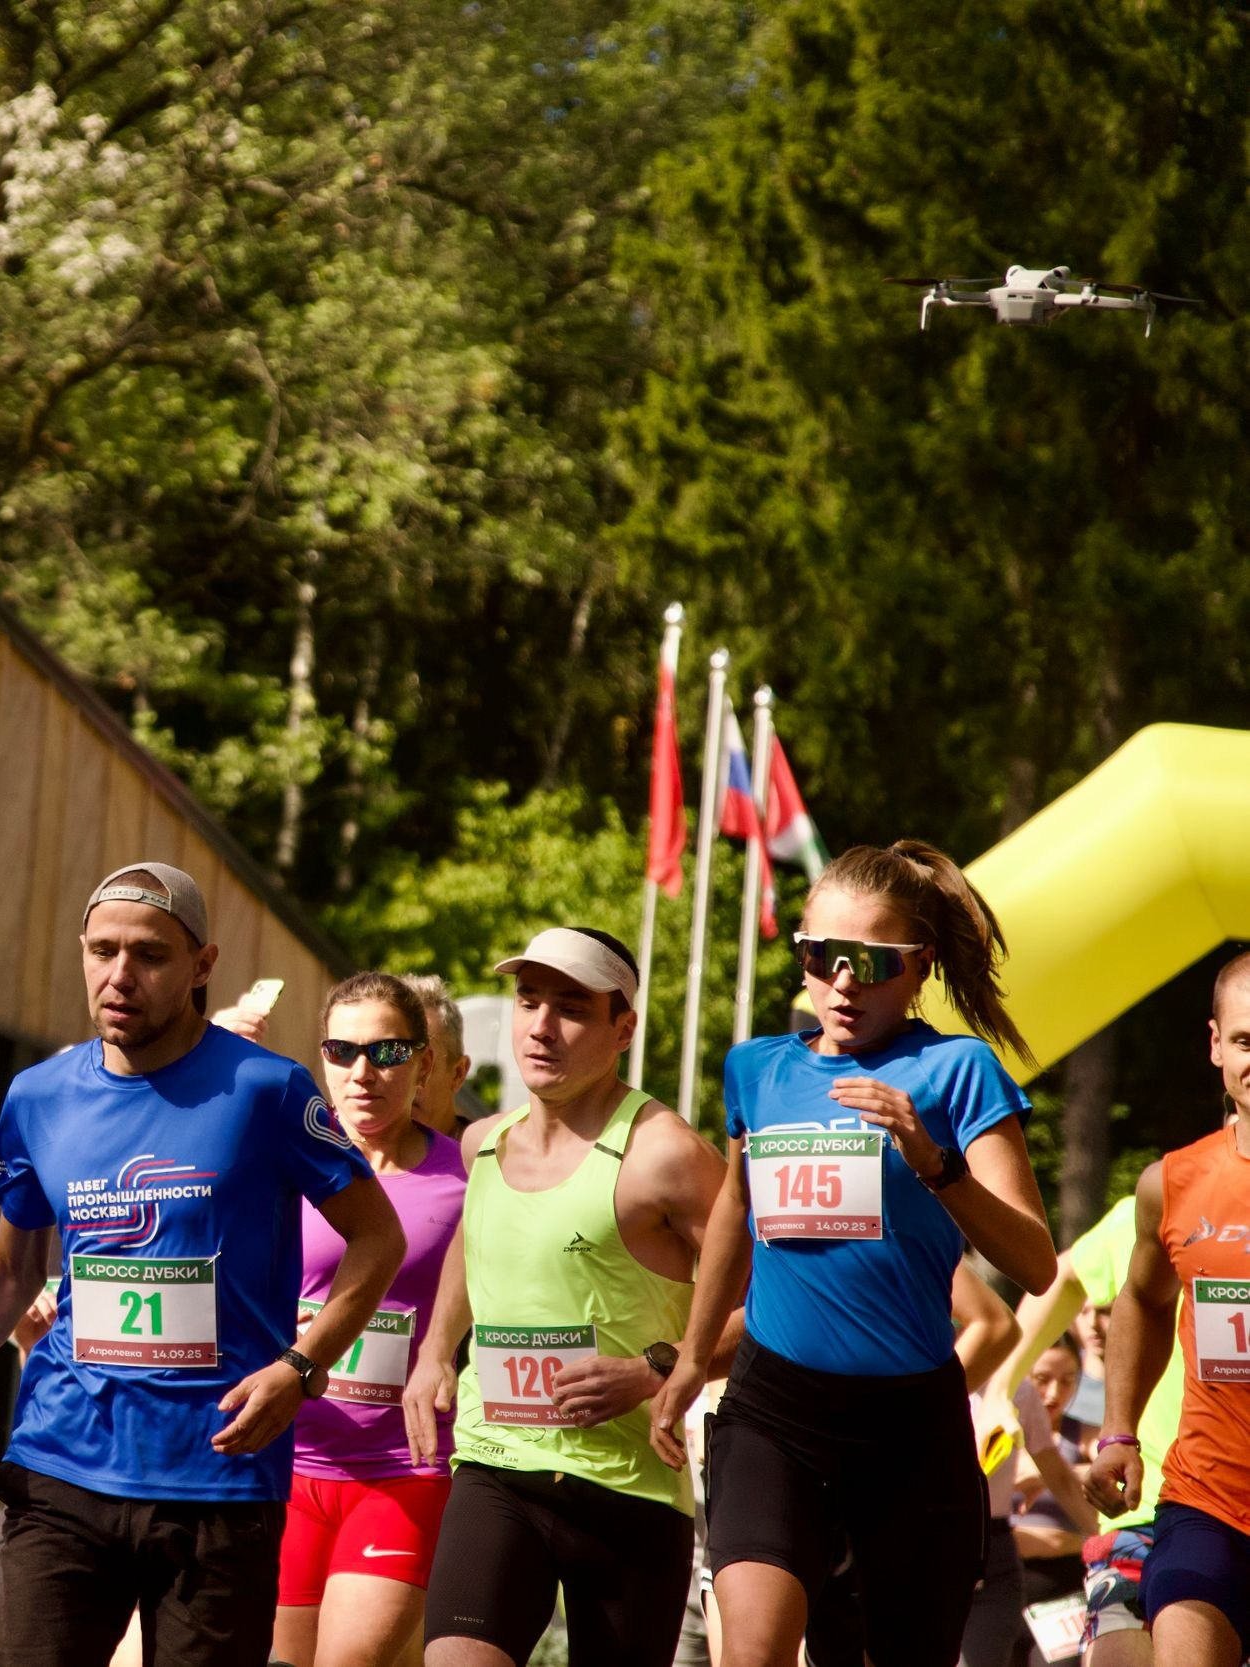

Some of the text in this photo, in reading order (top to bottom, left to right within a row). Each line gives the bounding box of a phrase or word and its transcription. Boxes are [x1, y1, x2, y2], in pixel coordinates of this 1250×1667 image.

[760, 1139, 866, 1154] КРОСС ДУБКИ
[67, 1178, 108, 1194] ЗАБЕГ
[774, 1164, 843, 1209] 145
[67, 1185, 212, 1208] ПРОМЫШЛЕННОСТИ
[69, 1205, 130, 1221] МОСКВЫ
[816, 1222, 867, 1232] 14.09.25
[85, 1263, 199, 1281] КРОСС ДУБКИ
[1208, 1286, 1250, 1300] КРОС
[119, 1290, 163, 1336] 21
[367, 1317, 398, 1330] БКИ
[485, 1331, 582, 1347] КРОСС ДУБКИ
[1227, 1312, 1250, 1353] 1
[88, 1346, 202, 1359] Апрелевка 14.09.25
[347, 1386, 392, 1398] 14.09.25
[493, 1409, 539, 1420] Апрелевка
